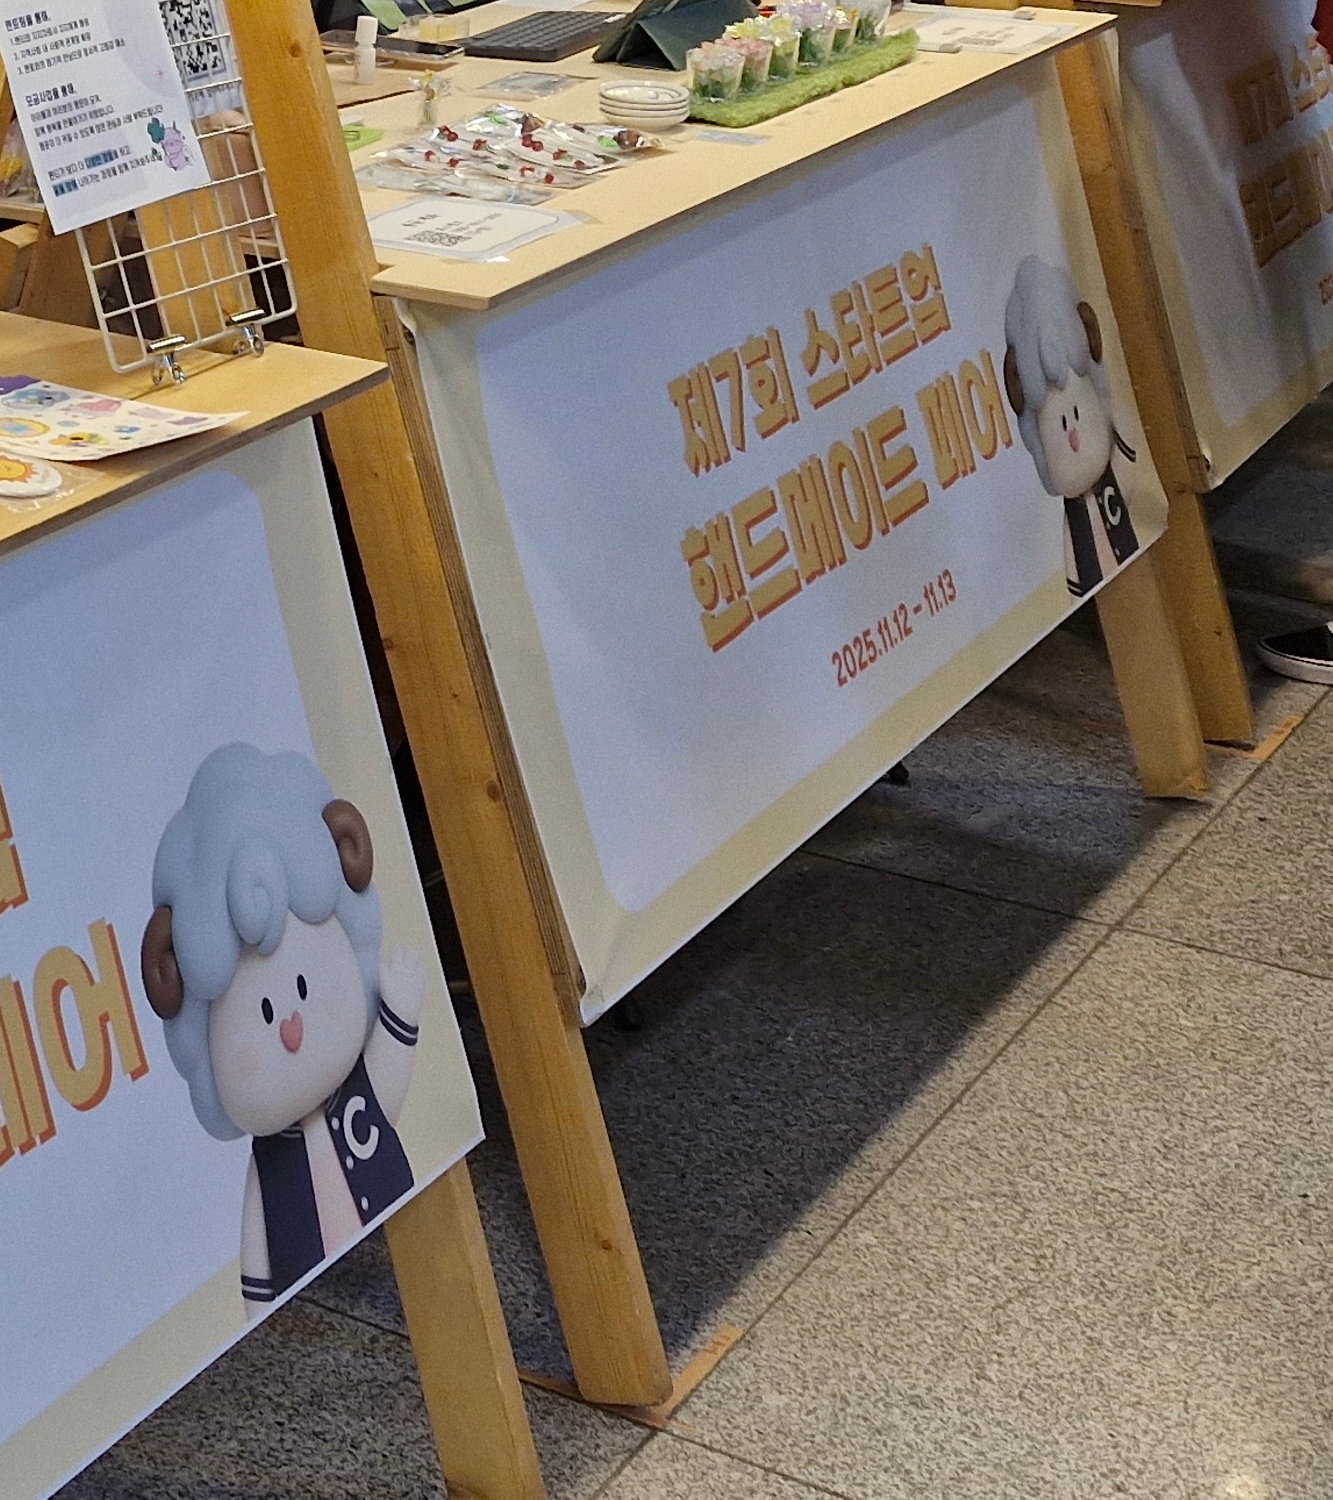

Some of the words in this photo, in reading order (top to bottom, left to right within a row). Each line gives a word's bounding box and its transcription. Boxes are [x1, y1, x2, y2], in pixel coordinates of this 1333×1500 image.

[669, 327, 799, 476] 제7회
[802, 244, 951, 404] 스타트업
[680, 410, 930, 652] 핸드메이드
[916, 350, 1014, 490] 페어
[831, 603, 914, 689] 2025.11.12
[923, 569, 958, 613] 11.13
